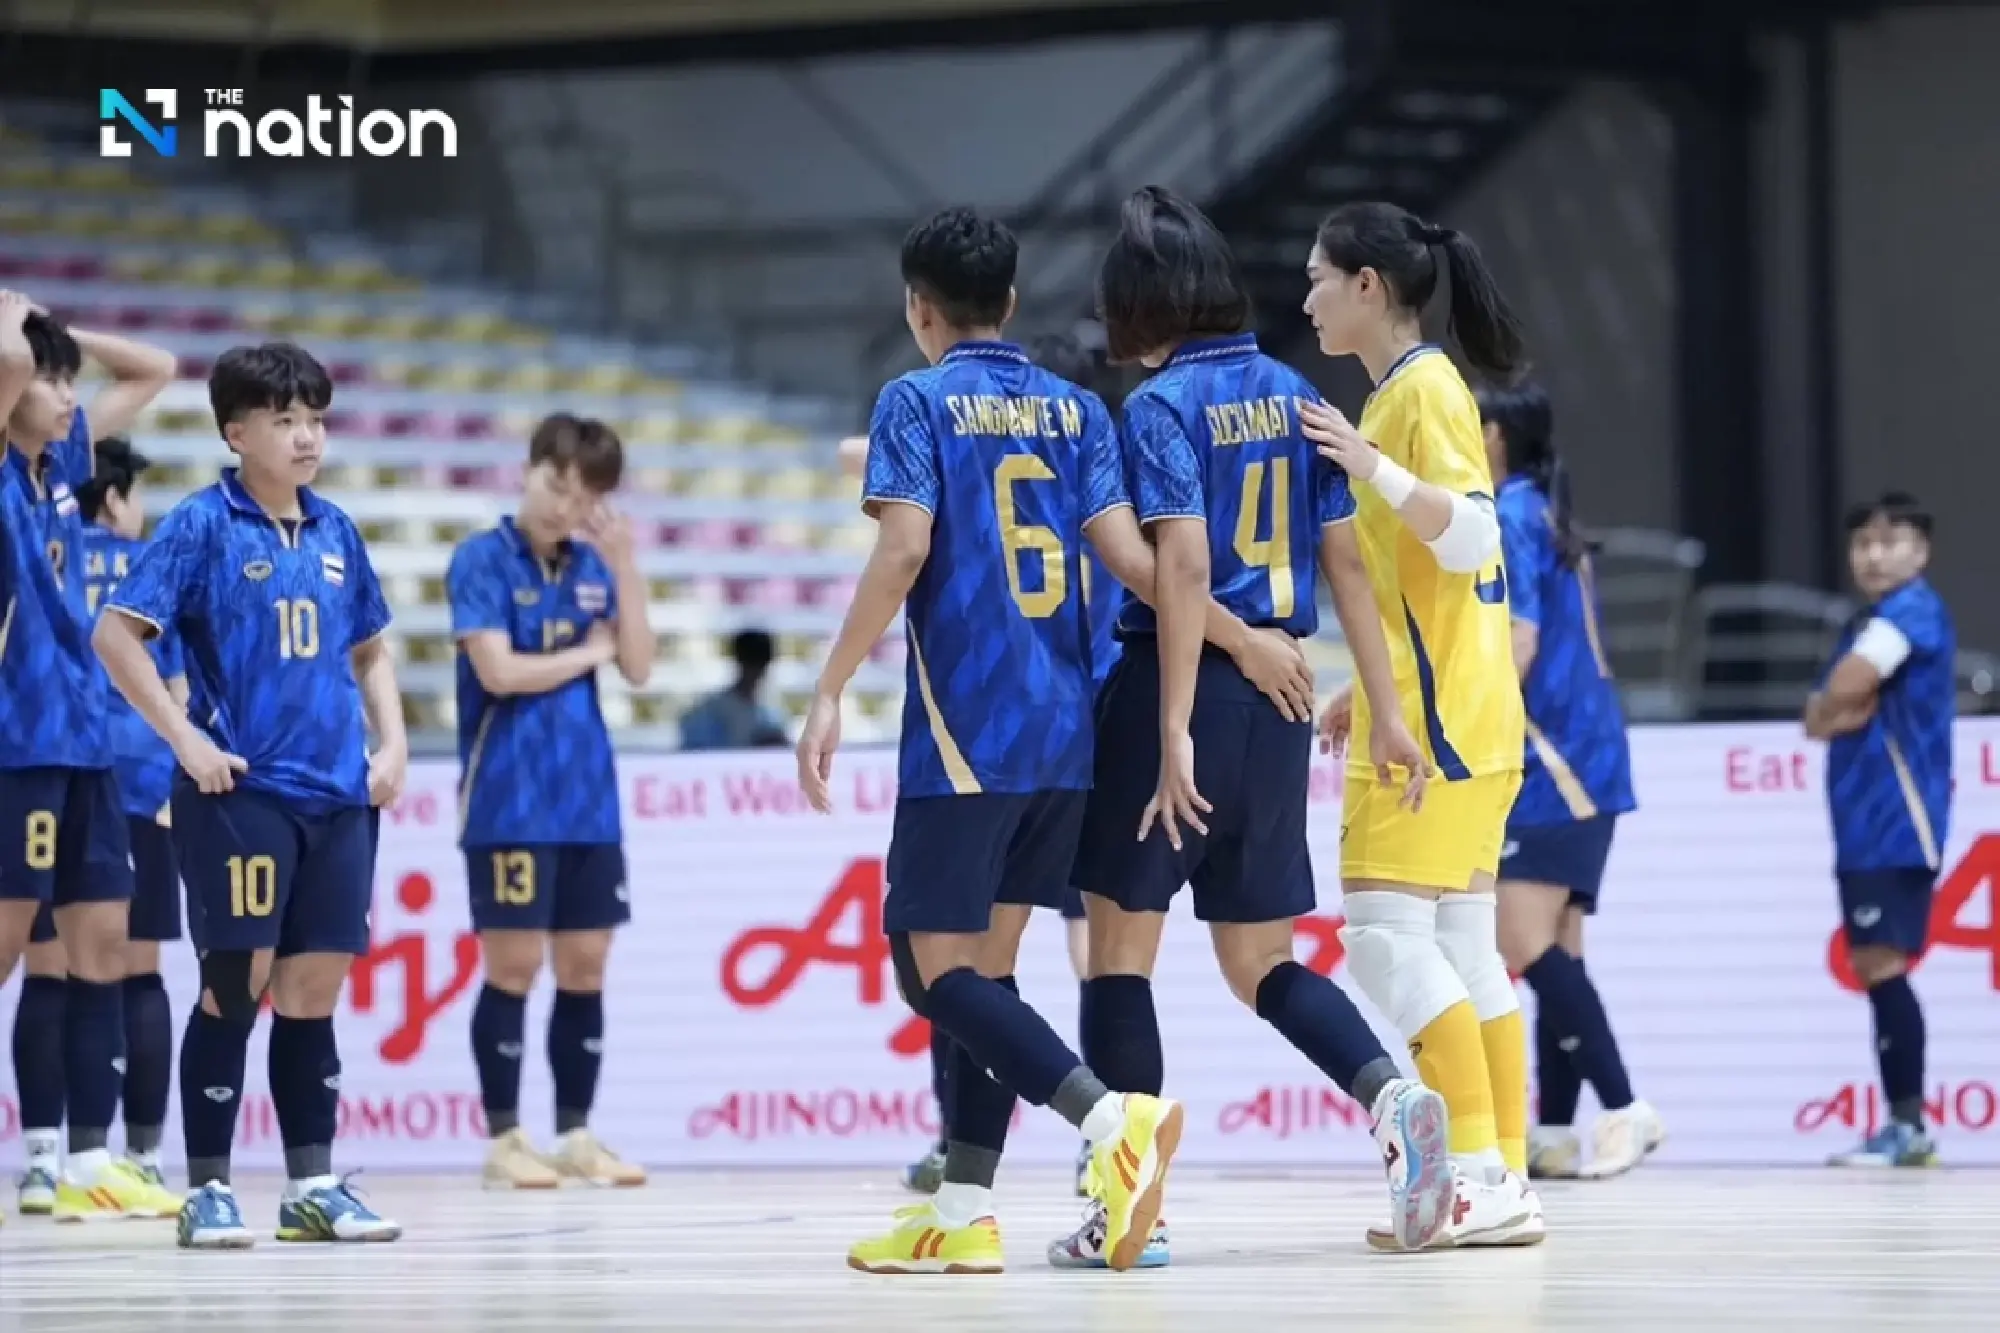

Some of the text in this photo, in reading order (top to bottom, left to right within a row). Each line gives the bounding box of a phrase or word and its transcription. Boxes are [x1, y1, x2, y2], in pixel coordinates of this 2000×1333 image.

[995, 454, 1065, 618] 6
[1234, 457, 1294, 618] 4
[274, 598, 319, 659] 10
[634, 773, 708, 820] Eat
[1726, 748, 1809, 792] Eat
[26, 811, 57, 868] 8
[227, 855, 276, 917] 10
[493, 852, 537, 905] 13
